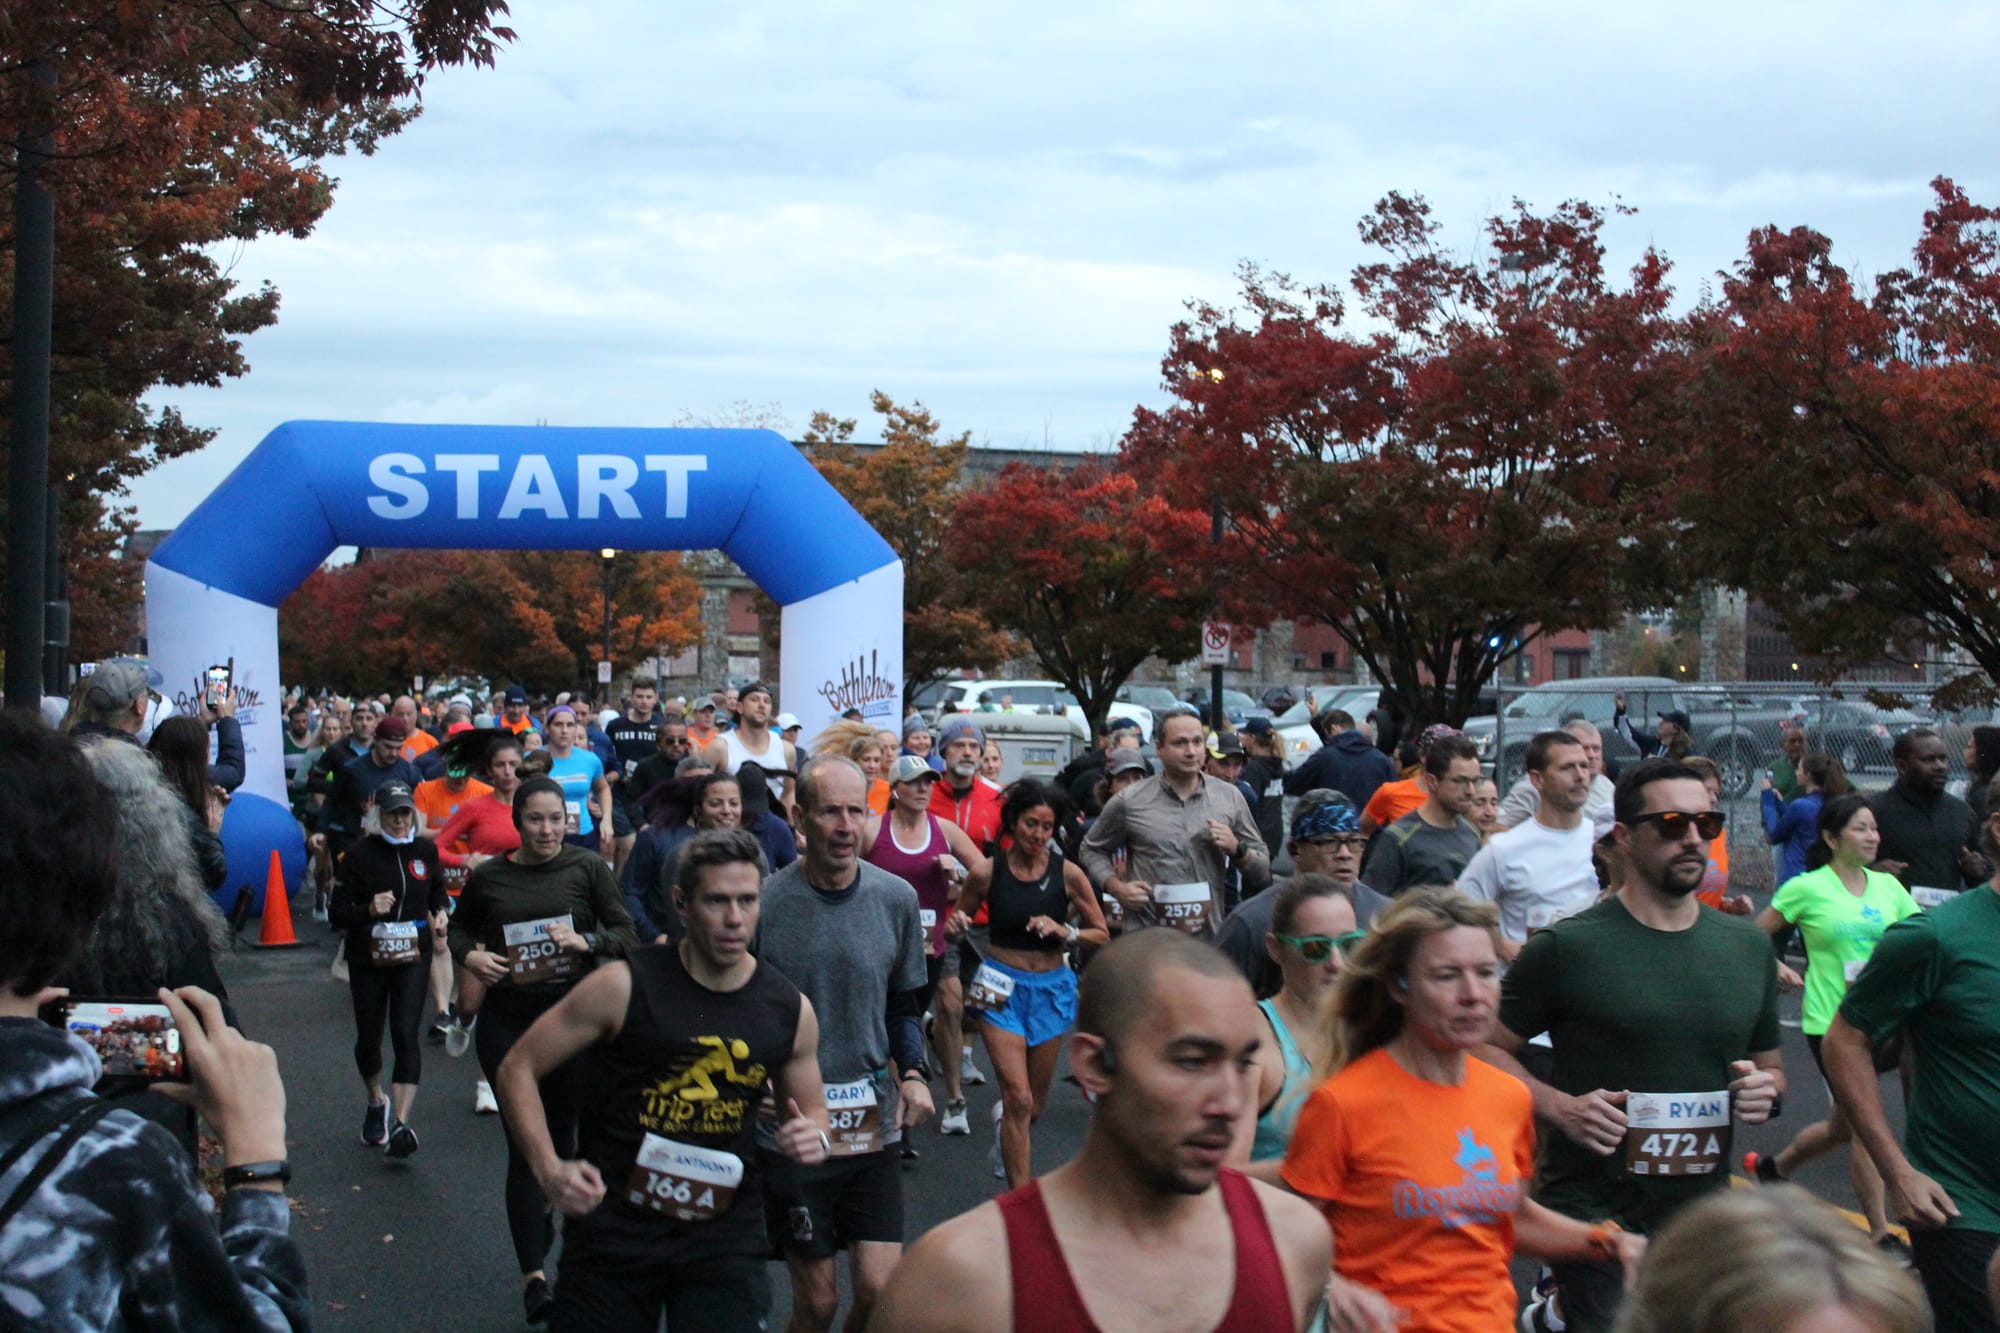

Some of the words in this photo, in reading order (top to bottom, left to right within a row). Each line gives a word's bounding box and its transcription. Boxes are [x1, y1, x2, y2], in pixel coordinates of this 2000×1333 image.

[367, 452, 708, 520] START
[817, 648, 899, 712] Bethlehem
[614, 731, 636, 740] PENN
[638, 731, 657, 741] STAT
[1165, 903, 1202, 918] 2579
[378, 939, 412, 952] 2388
[518, 941, 565, 960] 250
[826, 1085, 867, 1101] GARY
[642, 1088, 695, 1121] Trip
[1669, 1101, 1721, 1118] RYAN
[1640, 1133, 1699, 1157] 472
[1702, 1133, 1720, 1156] A
[675, 1153, 734, 1176] ANTHONY
[646, 1171, 692, 1204] 166
[695, 1186, 715, 1209] A
